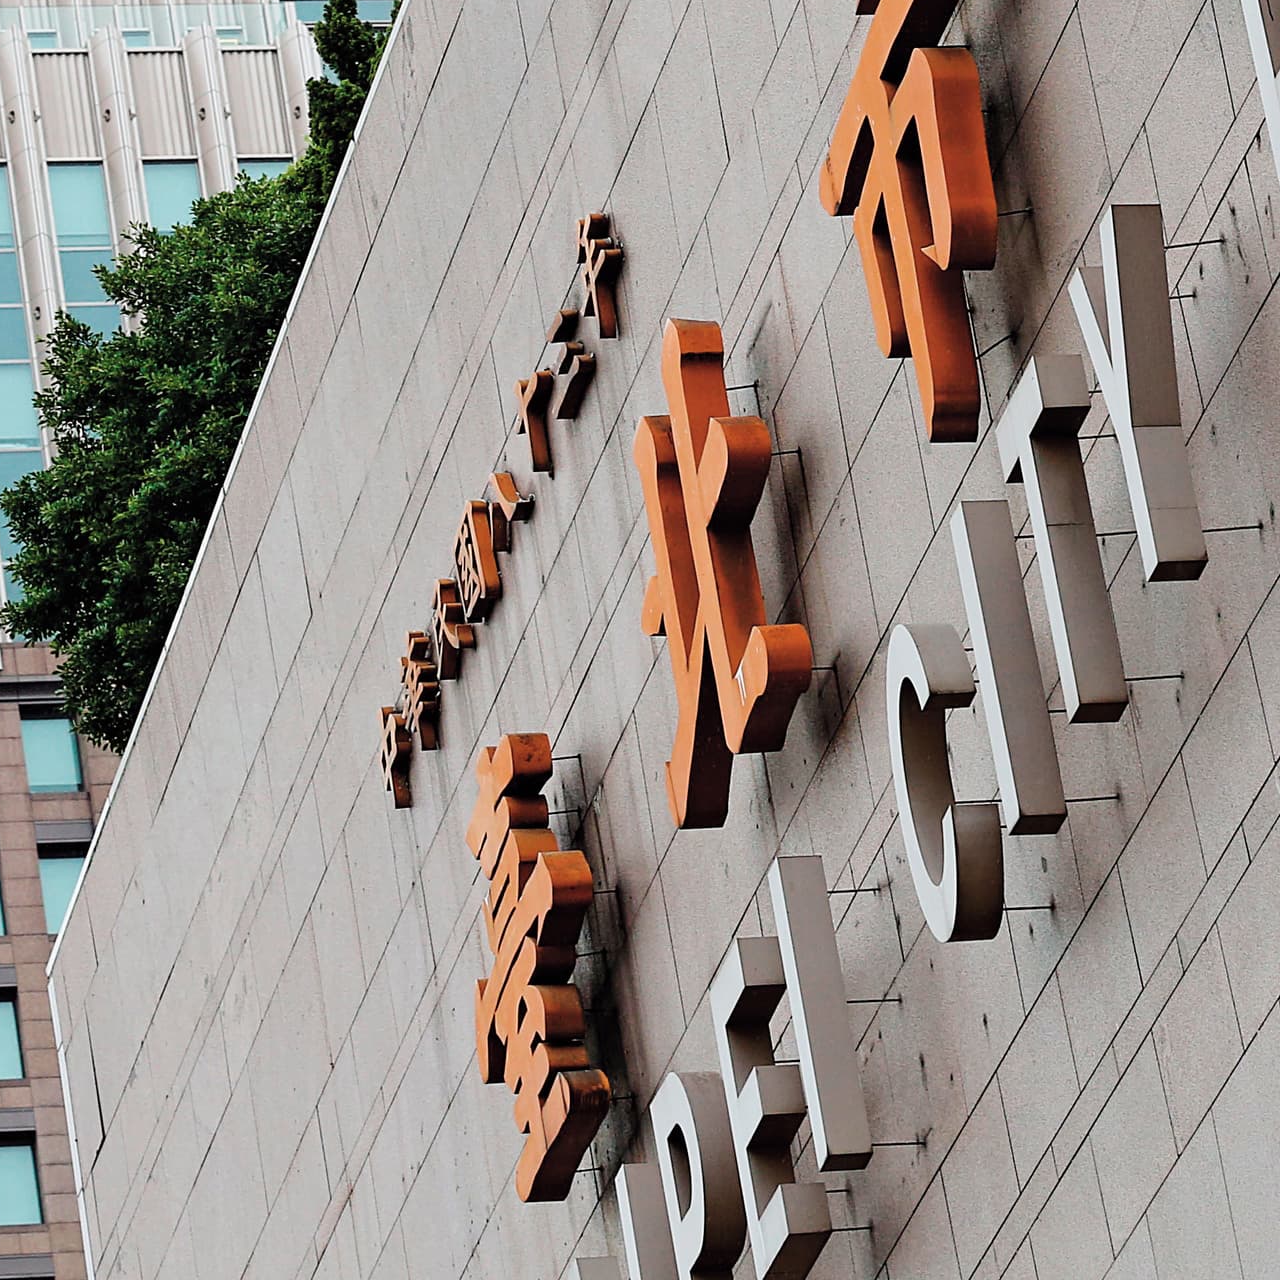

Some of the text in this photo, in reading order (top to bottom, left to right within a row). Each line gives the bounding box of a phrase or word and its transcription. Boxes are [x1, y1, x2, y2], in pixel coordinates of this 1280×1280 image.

[378, 211, 624, 809] 中華民國八十三年
[887, 204, 1208, 943] CITY
